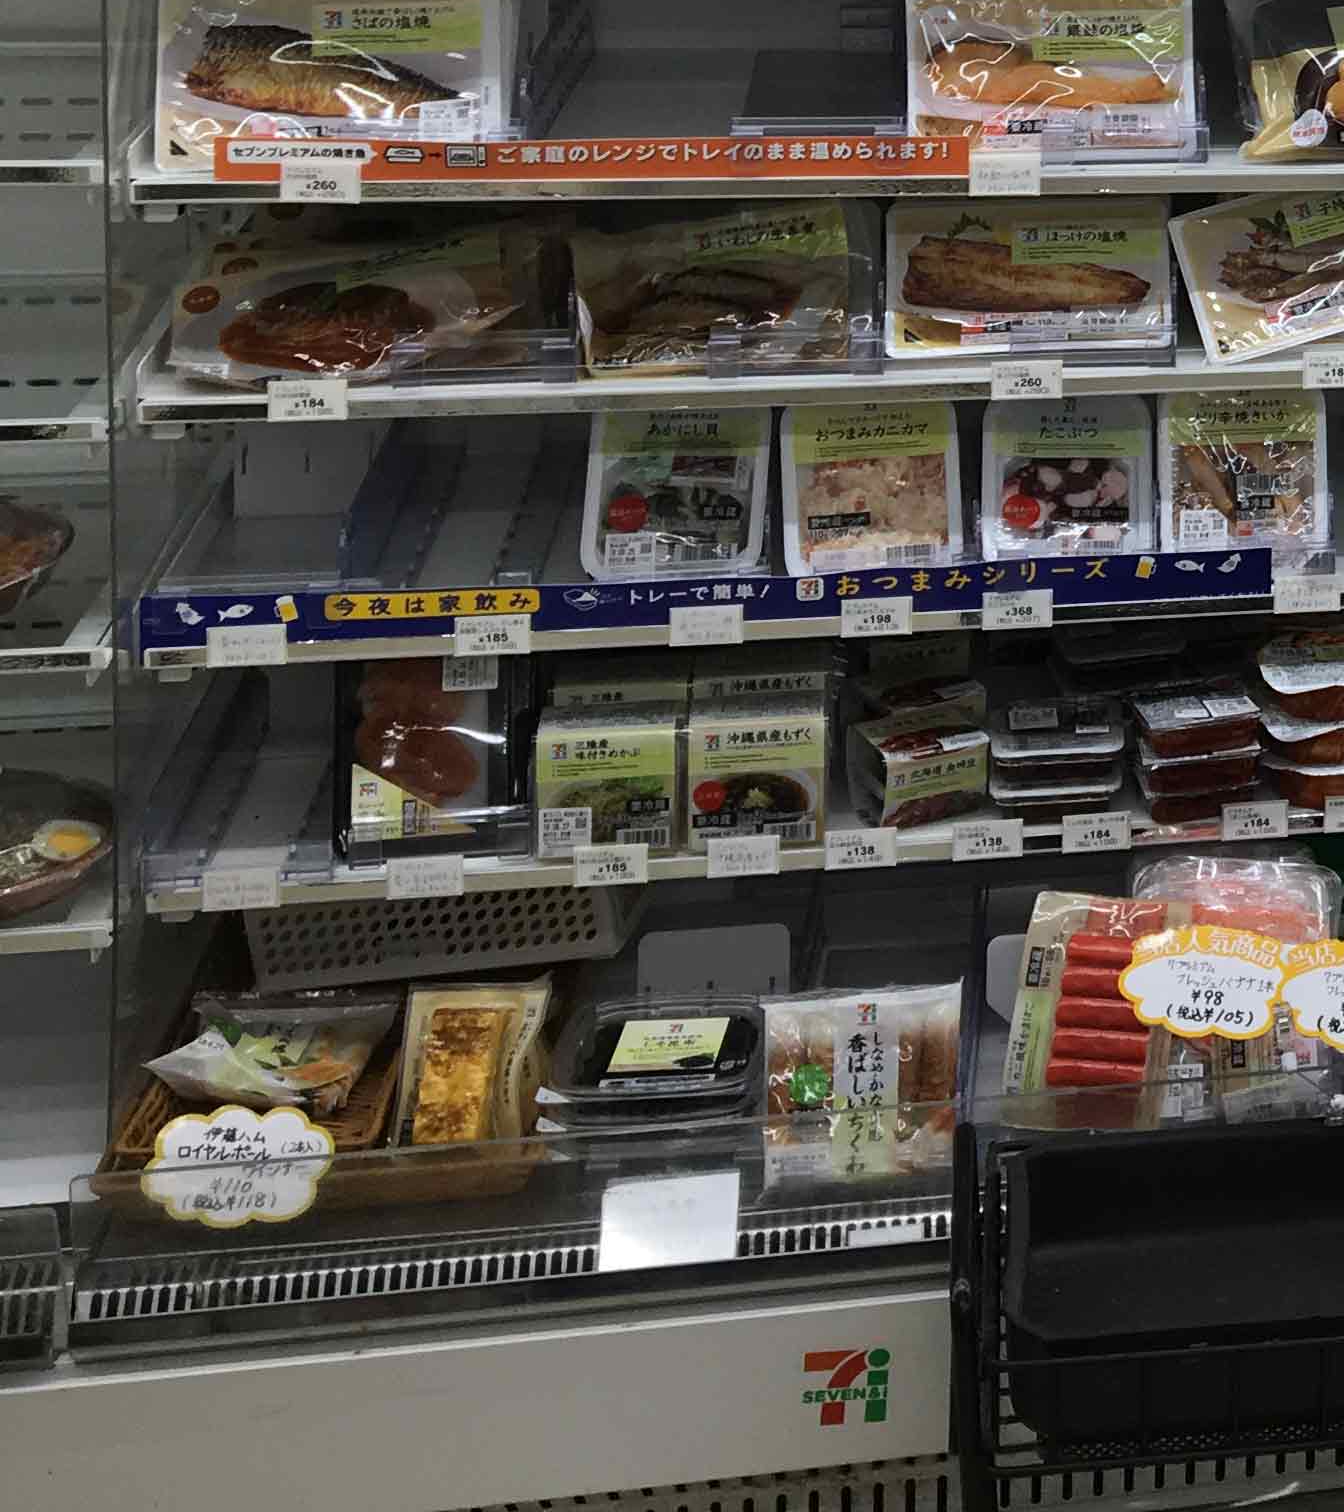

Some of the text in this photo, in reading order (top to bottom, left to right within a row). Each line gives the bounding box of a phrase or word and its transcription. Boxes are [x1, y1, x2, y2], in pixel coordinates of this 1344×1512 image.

[231, 145, 367, 161] セブンプレミアムの焼き魚
[306, 180, 336, 191] ¥260
[1014, 377, 1042, 387] ¥260
[295, 399, 324, 408] ¥184
[815, 422, 928, 442] おつまみカニカマ
[837, 560, 1109, 594] おつまみシリーズ
[628, 584, 771, 605] トレーで簡単！
[331, 592, 533, 616] 今夜は家飲み
[1005, 606, 1033, 617] ¥368
[863, 615, 891, 625] ¥198
[726, 728, 812, 745] 沖縄県産もずく
[1192, 990, 1224, 1005] ¥98
